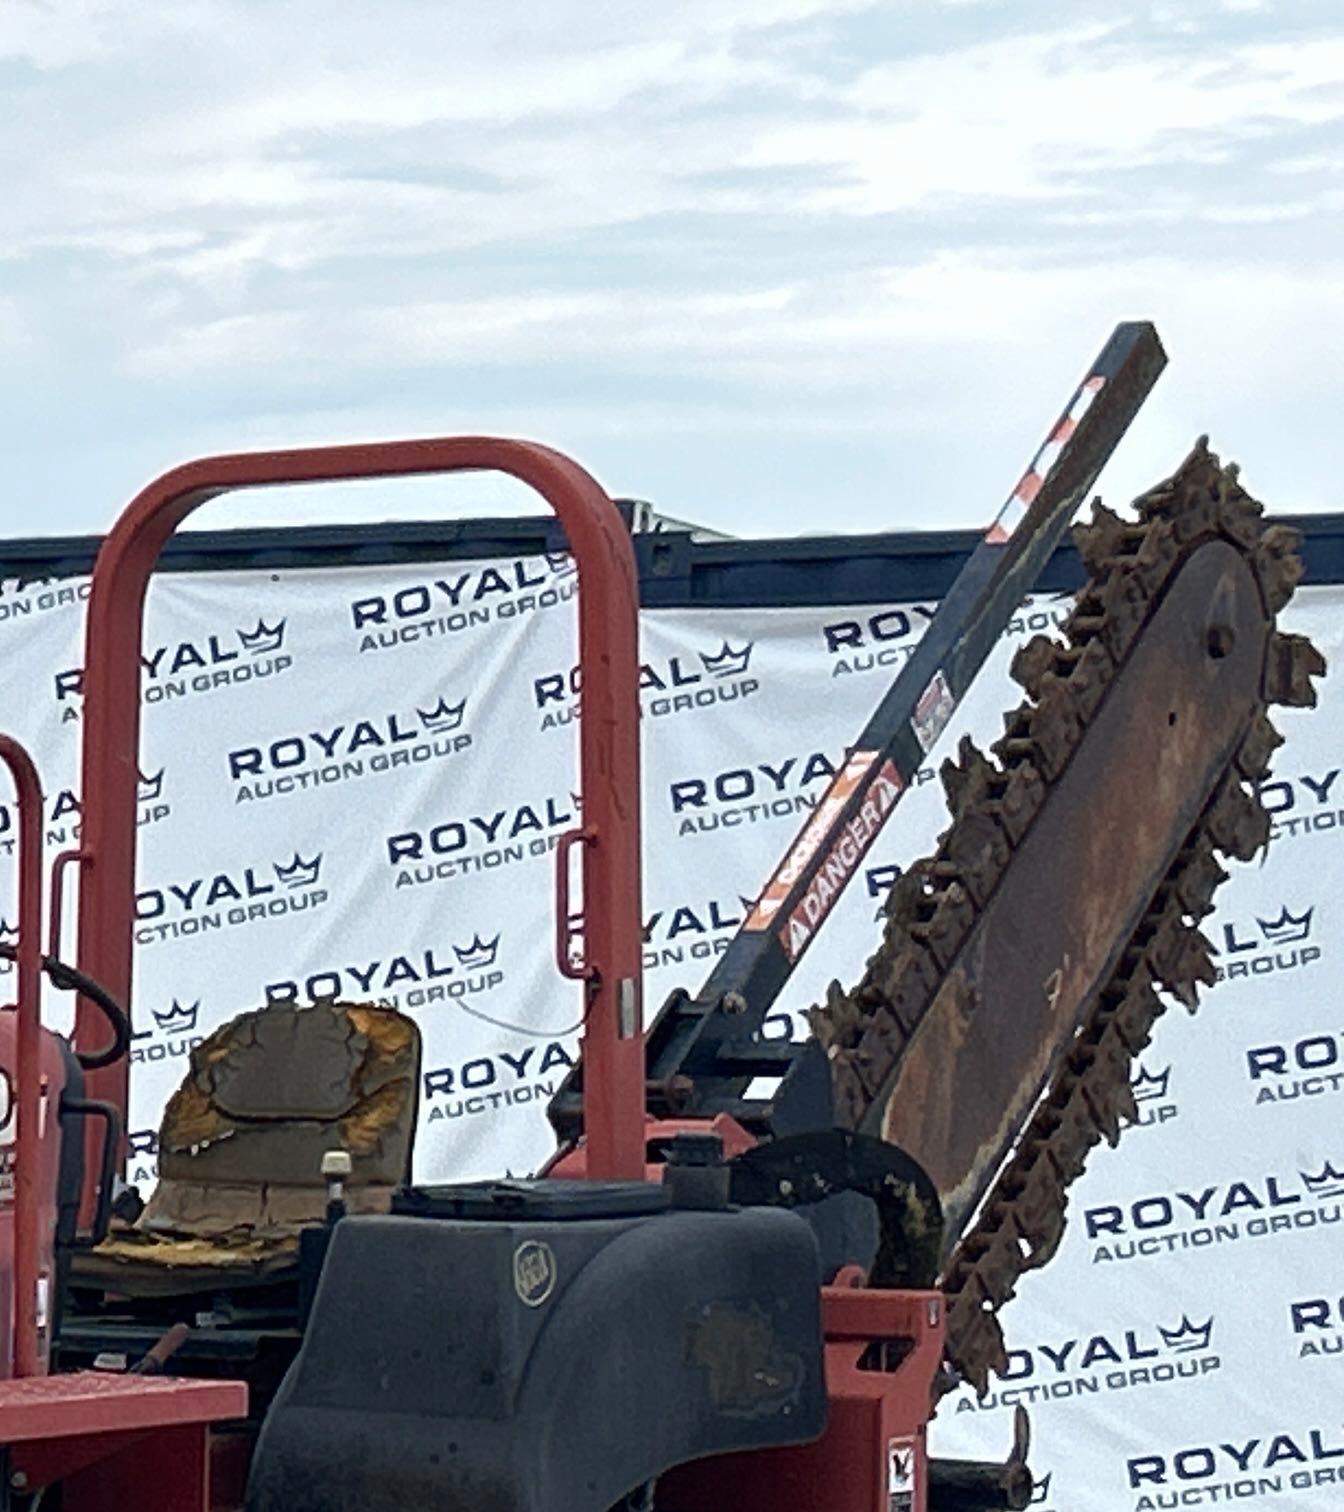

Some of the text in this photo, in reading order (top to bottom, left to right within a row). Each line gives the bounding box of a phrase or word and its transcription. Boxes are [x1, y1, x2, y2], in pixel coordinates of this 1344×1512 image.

[353, 562, 545, 628] ROYAL
[360, 586, 579, 653] AUCTION GROU
[192, 654, 290, 691] GROUP
[652, 678, 758, 716] GROUP
[229, 715, 418, 778] ROYAL
[235, 734, 472, 803] AUCTION GROUP
[672, 752, 839, 811] ROYA
[388, 799, 570, 863] ROYAL
[130, 869, 274, 921] OYAL
[394, 845, 524, 888] AUCTION
[802, 804, 881, 925] DANGER
[228, 888, 327, 924] GROUP
[406, 970, 508, 1006] GROUP
[1085, 1175, 1302, 1241] ROYAL
[1091, 1201, 1339, 1268] AUCTION GROU
[1106, 1351, 1220, 1388] GROUP
[1127, 1426, 1344, 1490] ROYAL
